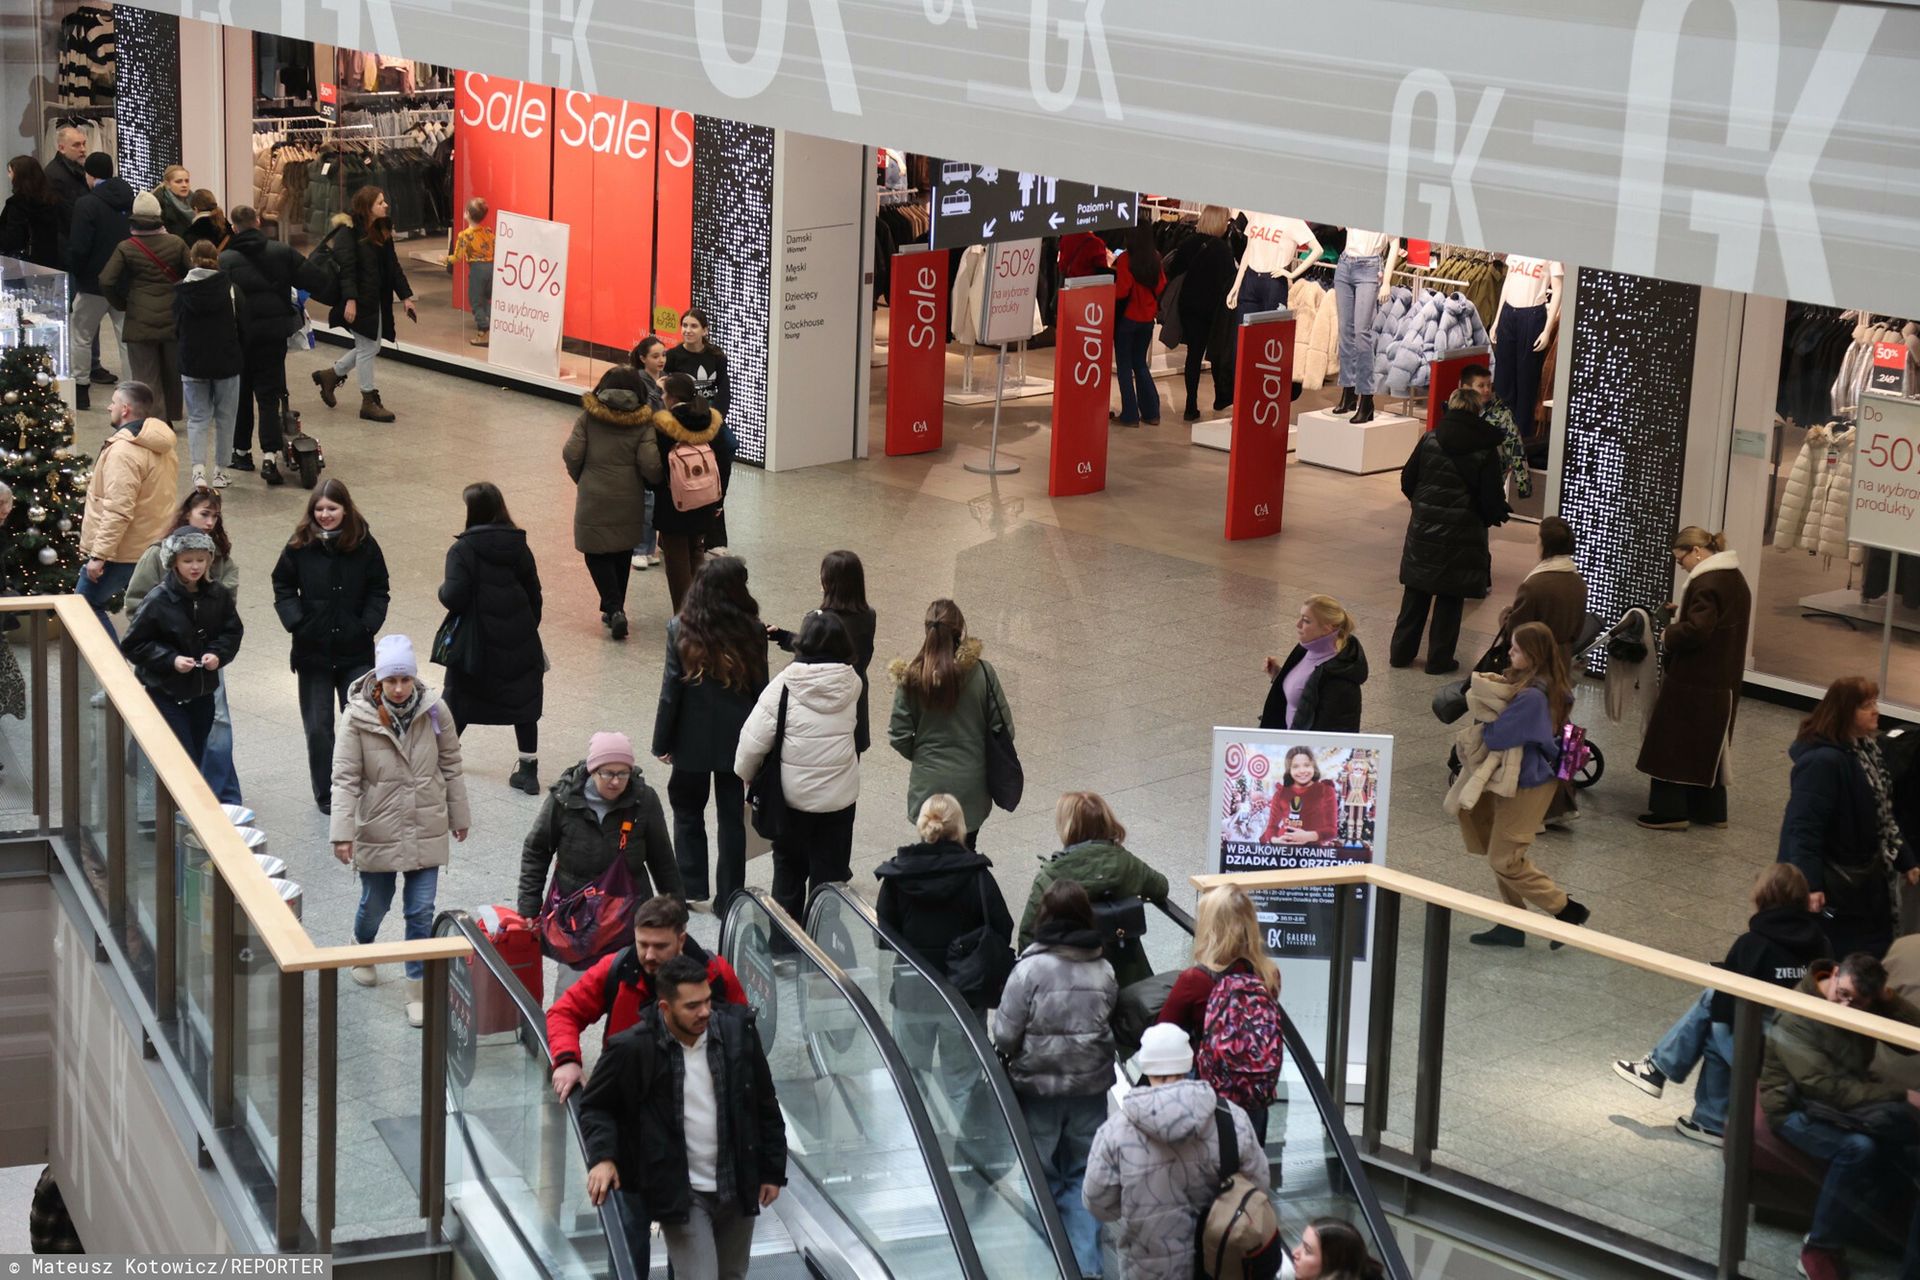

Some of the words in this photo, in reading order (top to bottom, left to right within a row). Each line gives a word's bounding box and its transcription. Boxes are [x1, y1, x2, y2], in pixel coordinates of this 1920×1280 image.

[460, 71, 546, 138] Sale
[560, 90, 650, 159] Sale
[1077, 203, 1104, 214] Poziom
[1104, 200, 1114, 210] +1
[1010, 210, 1024, 222] WC
[499, 221, 514, 239] Do
[1249, 225, 1283, 243] SALE
[786, 233, 812, 245] Damski
[786, 246, 807, 254] Women
[785, 263, 807, 274] Męski
[995, 247, 1036, 278] -50%
[497, 250, 561, 297] -50%
[784, 290, 819, 302] Dziecięcy
[992, 289, 1001, 299] na
[1002, 286, 1030, 300] wybrane
[494, 299, 506, 312] na
[507, 301, 550, 323] wybrane
[908, 266, 937, 351] Sale
[991, 301, 1020, 315] produkty
[493, 318, 535, 342] produkty
[783, 317, 825, 330] Clockhouse
[1074, 301, 1104, 389] Sale
[1876, 346, 1899, 360] 50%
[1252, 337, 1284, 429] Sale
[1863, 405, 1883, 422] Do
[1860, 433, 1920, 475] -50
[1858, 480, 1874, 492] na
[1856, 497, 1915, 521] produkty
[1226, 844, 1237, 854] W
[1237, 844, 1293, 857] BAJKOWEJ
[1295, 847, 1337, 859] KRAINIE
[1225, 855, 1278, 867] DZIADKA
[1280, 857, 1297, 868] DO
[1267, 928, 1282, 949] GK
[1286, 933, 1317, 942] GALERIA
